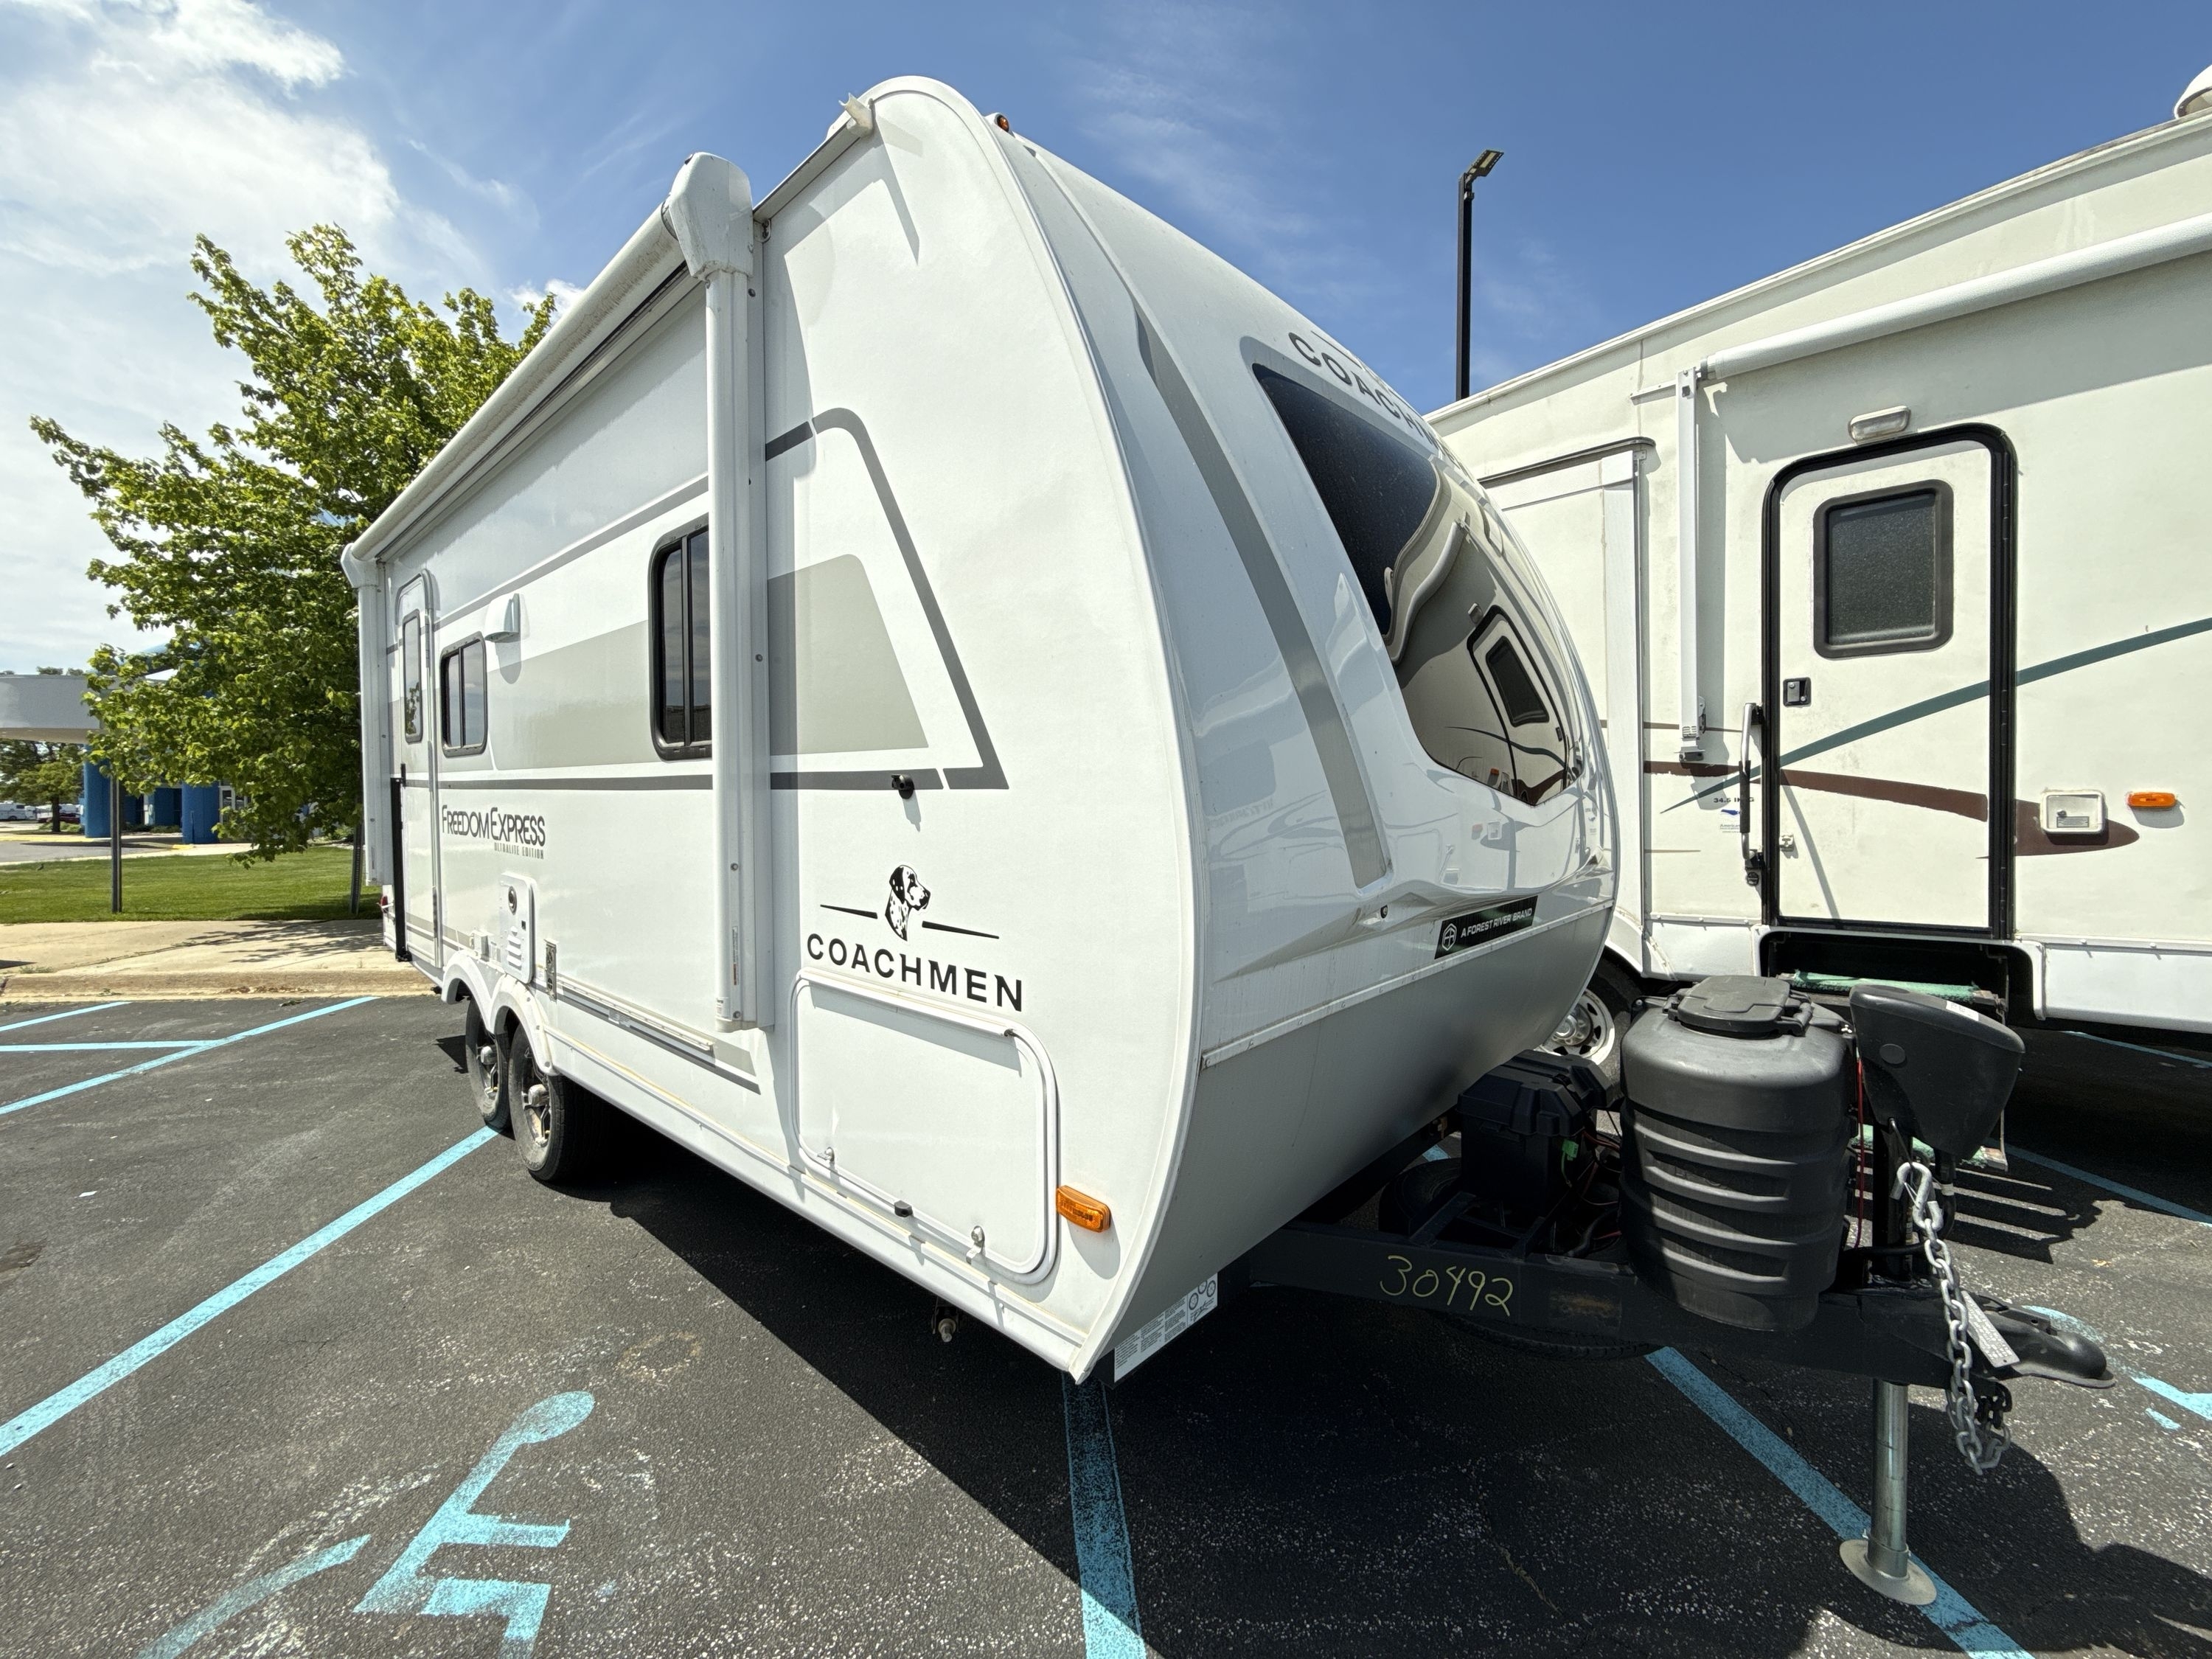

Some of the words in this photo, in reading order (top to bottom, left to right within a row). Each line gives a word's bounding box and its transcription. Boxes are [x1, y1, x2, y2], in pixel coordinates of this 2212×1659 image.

[490, 807, 546, 846] EXPRESS
[494, 842, 519, 855] ULTRALITE
[522, 846, 544, 859] EDITION
[1461, 928, 1467, 938] A
[1467, 920, 1493, 936] FOREST
[1493, 914, 1511, 928] RIVER
[1512, 908, 1533, 921] BRAND
[807, 933, 1022, 1012] COACHMEN
[1380, 1255, 1513, 1316] 30492
